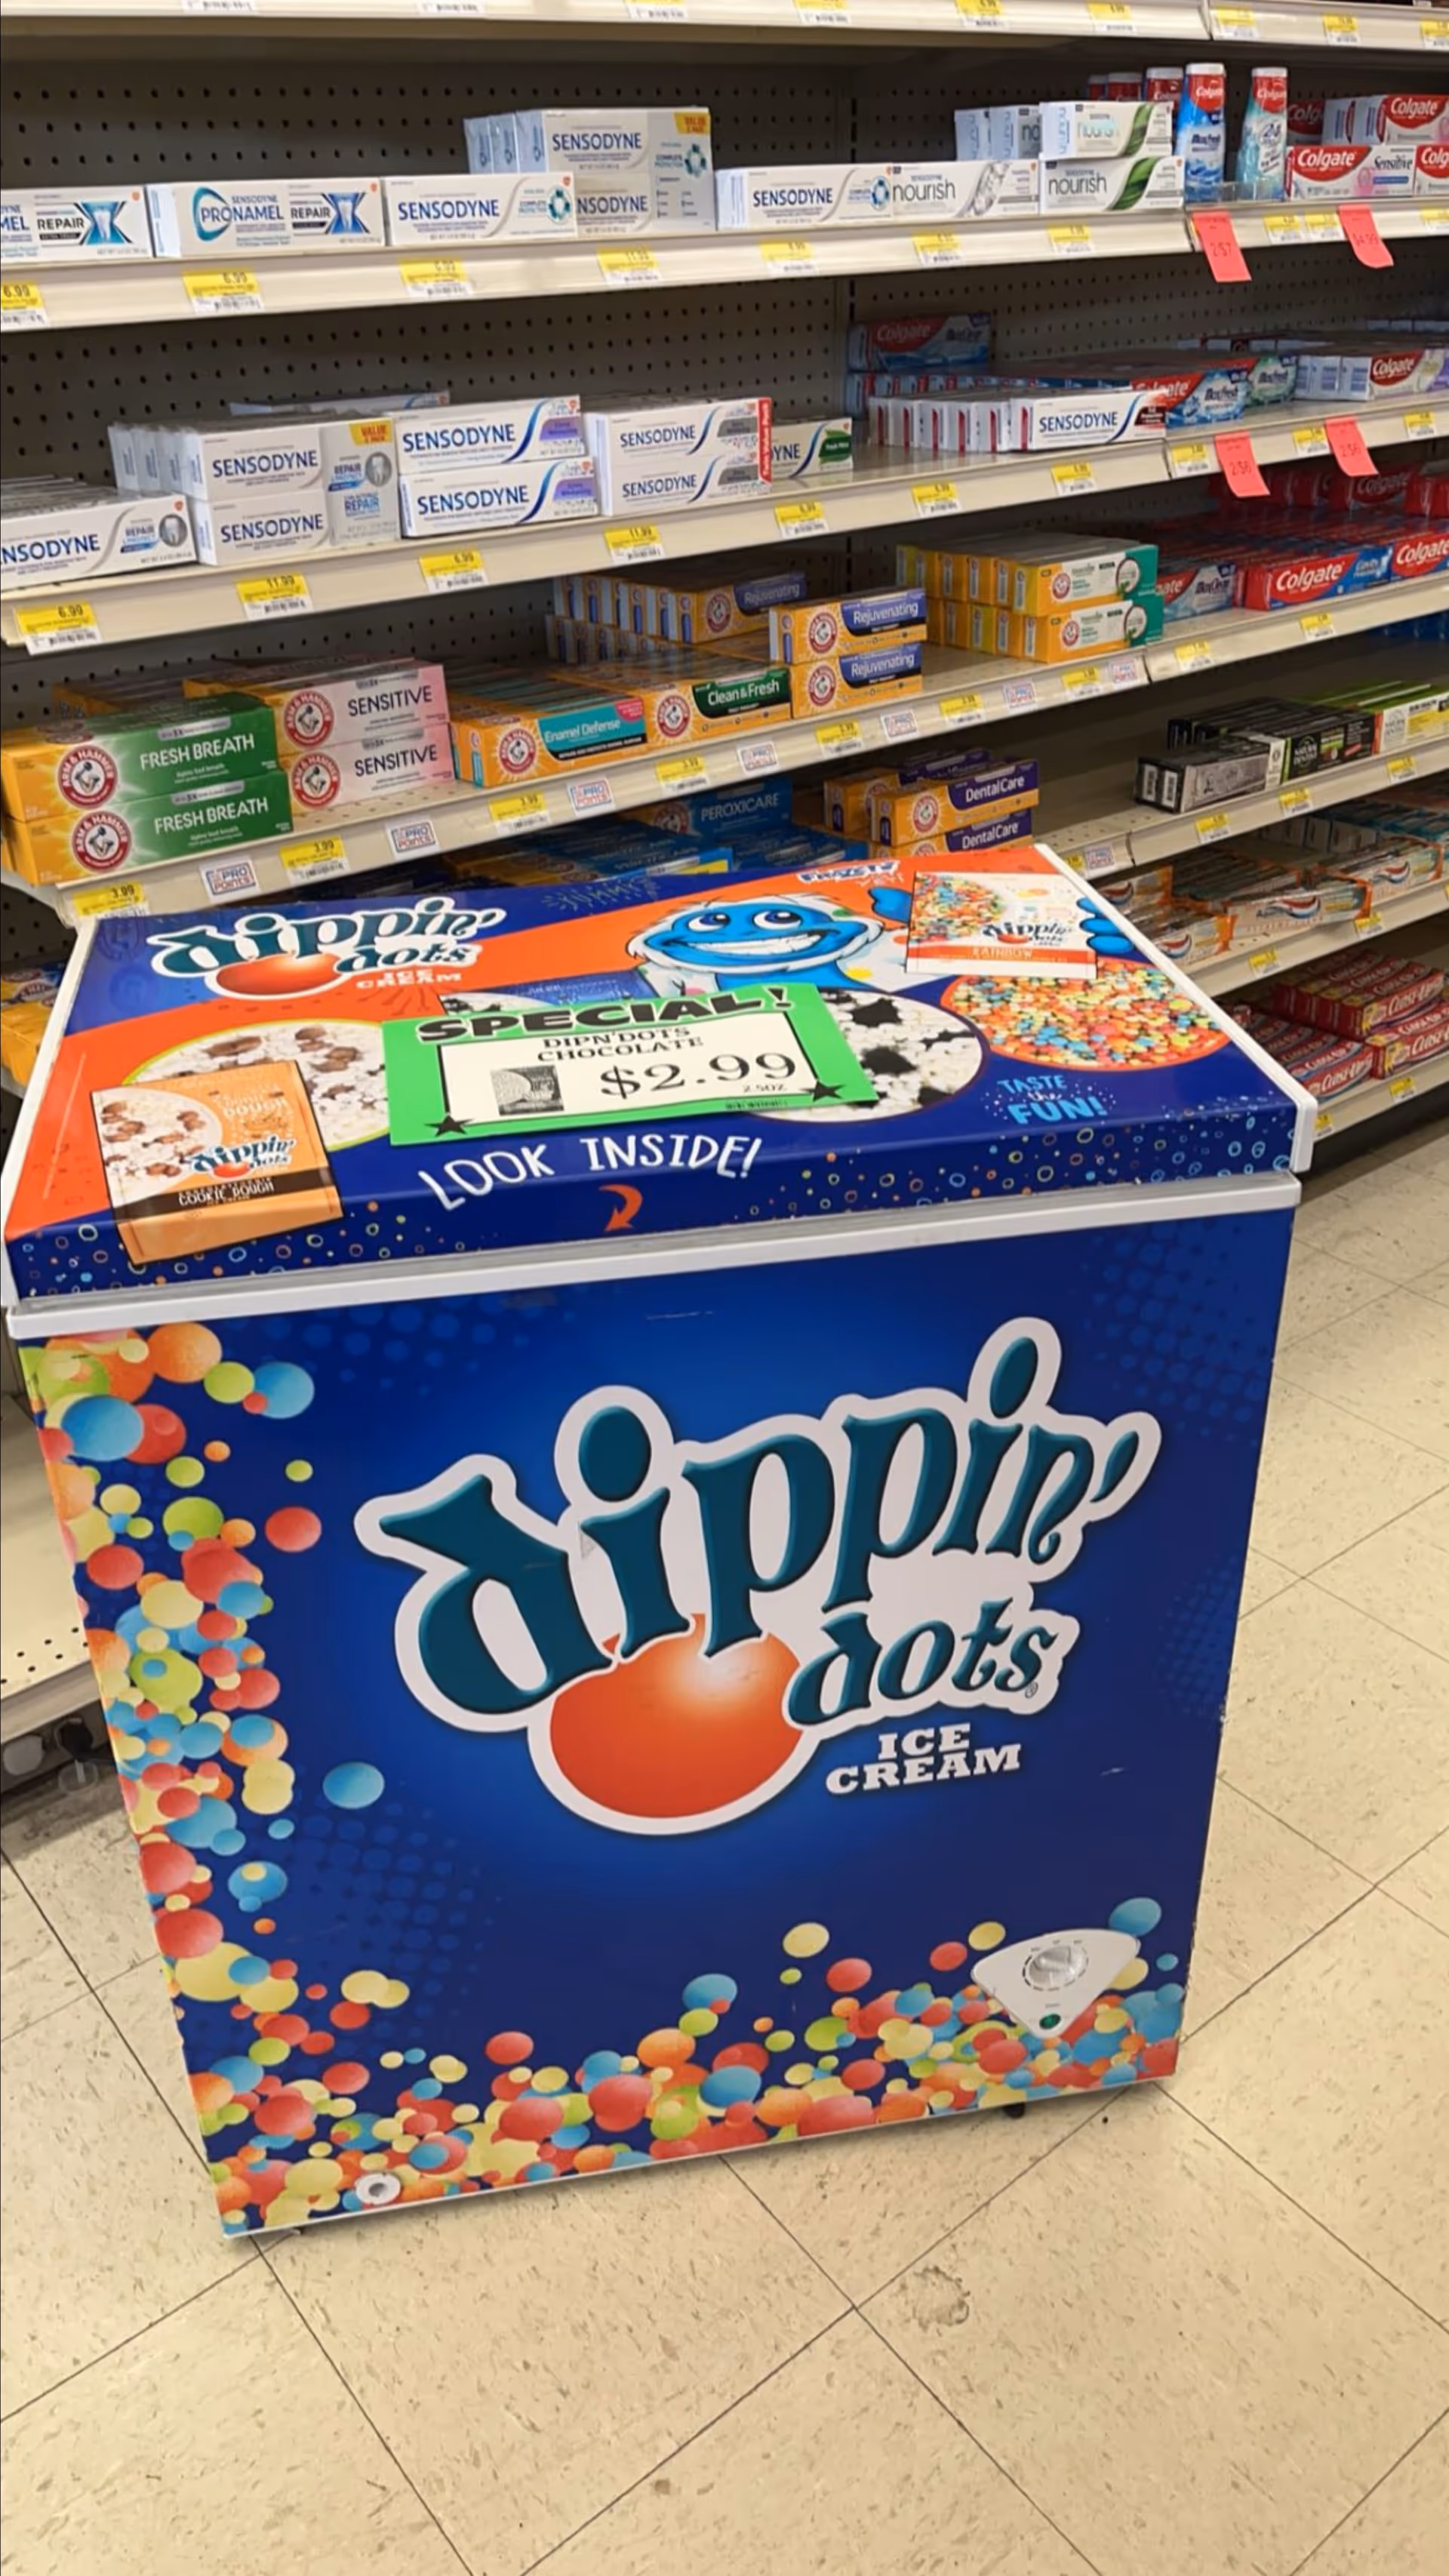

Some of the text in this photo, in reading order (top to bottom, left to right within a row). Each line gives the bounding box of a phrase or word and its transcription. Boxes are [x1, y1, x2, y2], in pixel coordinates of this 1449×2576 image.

[1391, 97, 1437, 119] Colgate
[552, 133, 642, 151] SENSODYNE
[1297, 149, 1356, 168] Colgate
[1420, 149, 1449, 168] Colg
[892, 180, 956, 204] nourish
[1048, 175, 1107, 195] nourish
[231, 195, 278, 205] SENSODYNE
[398, 199, 500, 220] SENSODYNE
[577, 196, 649, 215] NSODYNE
[752, 187, 833, 208] SENSODYNE
[36, 217, 85, 230] REPAIR
[201, 205, 285, 223] PRONAMEL
[290, 207, 332, 220] REPAIR
[2, 284, 31, 298] 6.99
[877, 324, 931, 344] Colgate
[1372, 359, 1415, 377] Colgate
[1039, 411, 1118, 433] SENSODYNE
[402, 423, 516, 453] SENSODYNE
[620, 424, 696, 448] SENSODYNE
[212, 451, 319, 479] SENSODYNE
[622, 474, 697, 498] SENSODYNE
[345, 498, 380, 512] REPAIR
[417, 485, 530, 516] SENSODYNE
[221, 513, 325, 543] SENSODYNE
[0, 533, 100, 562] NSODYNE
[1396, 538, 1449, 565] Colgate
[266, 575, 294, 588] 11.99
[1276, 564, 1343, 592] Colgate
[744, 583, 799, 605] Rejuvenating
[58, 605, 83, 617] 6.99
[854, 603, 918, 624] Rejuvenating
[851, 654, 915, 679] Rejuvenating
[347, 685, 432, 717] SENSITIVE
[545, 719, 620, 743] Enamel Defense
[140, 734, 254, 770] FRESH BREATH
[354, 744, 438, 777] SENSITIVE
[964, 777, 1024, 802] DentalCare
[154, 796, 269, 835] FRESH BREATH
[700, 793, 779, 821] PEROXICARE
[961, 822, 1019, 849] DentalCare
[222, 867, 248, 880] PRO
[112, 885, 134, 898] 3.99
[155, 896, 498, 970] dippin'
[336, 943, 472, 972] dots
[420, 987, 791, 1042] SPECIAL!
[537, 1036, 703, 1063] CHOCOLATE
[543, 1027, 690, 1048] DIPN'DOTS
[600, 1052, 796, 1097] $2.99
[997, 1075, 1067, 1094] TASTE
[1008, 1095, 1108, 1124] FUN!
[419, 1134, 761, 1210] LOOK INSIDE!
[178, 1190, 227, 1205] COOKIE
[232, 1181, 275, 1199] DOUGH
[379, 1336, 1140, 1715] dippin'
[789, 1599, 1059, 1725] dots
[878, 1723, 971, 1760] ICE
[826, 1743, 1021, 1794] CREAM
